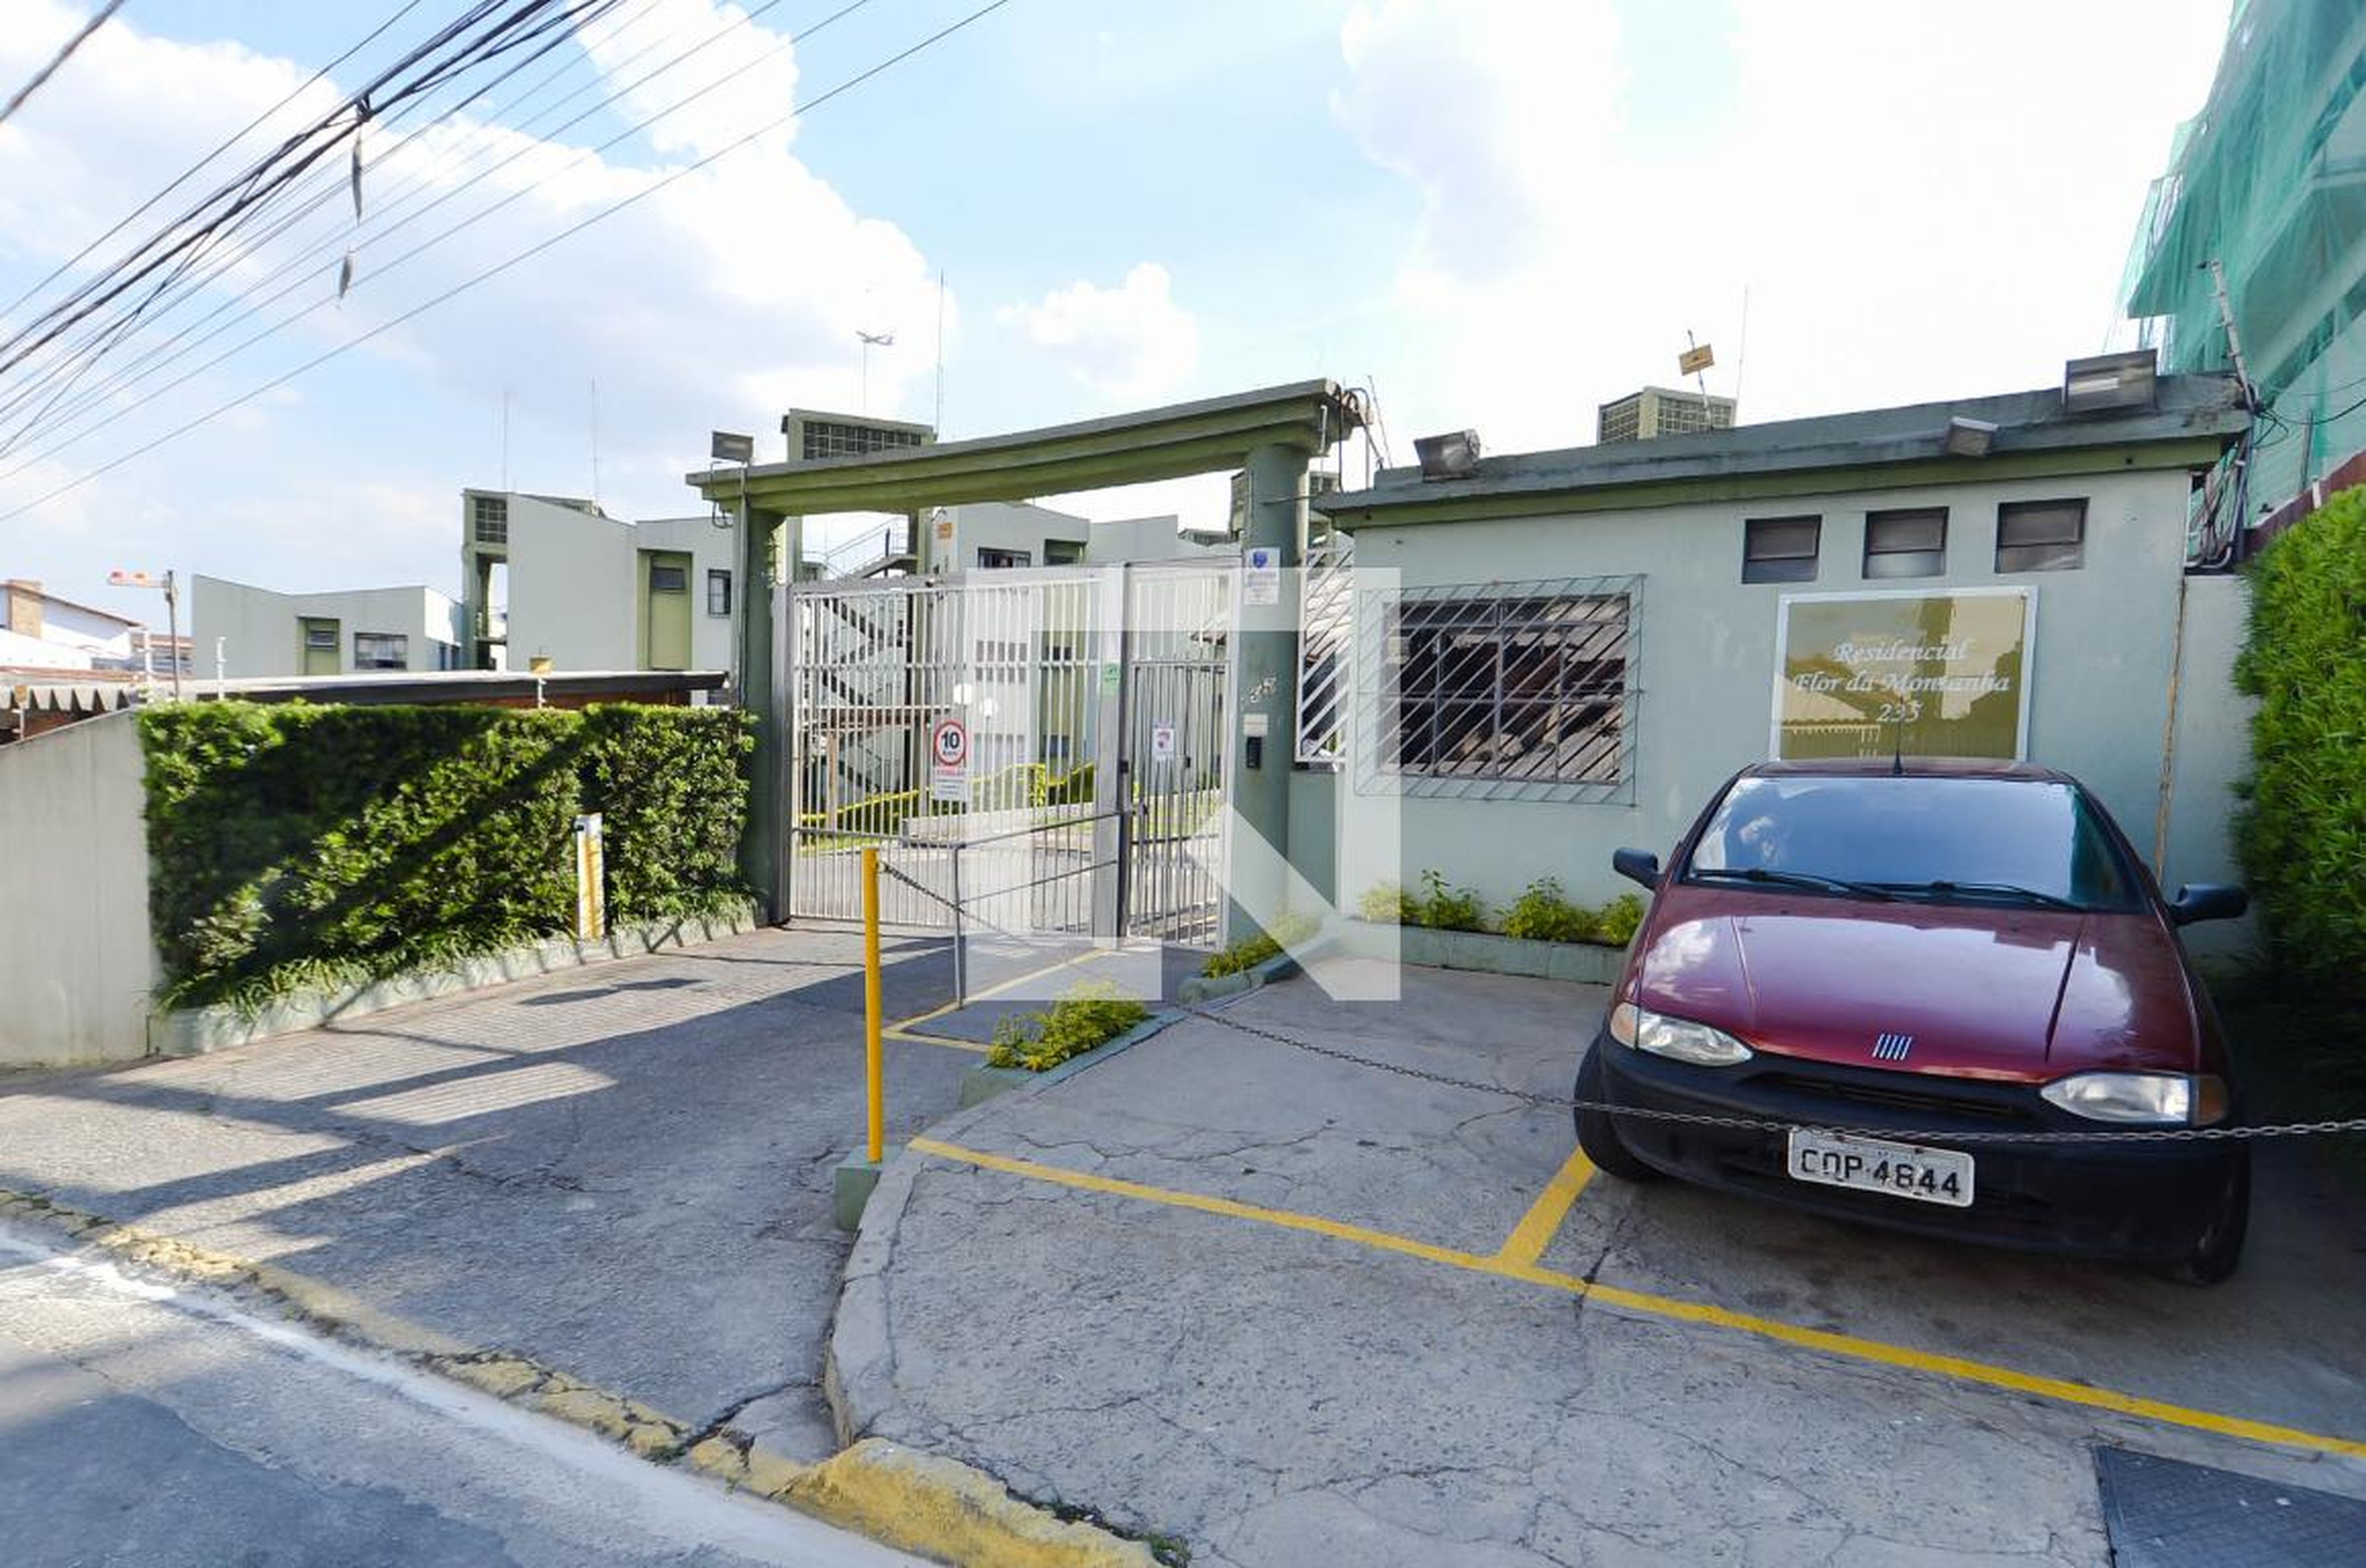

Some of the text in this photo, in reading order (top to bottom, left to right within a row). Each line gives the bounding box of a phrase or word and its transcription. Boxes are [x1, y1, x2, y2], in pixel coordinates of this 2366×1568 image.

[1832, 639, 1968, 664] Residencial
[1794, 670, 1839, 692] Flor
[1845, 670, 1873, 691] da
[941, 731, 960, 749] 10
